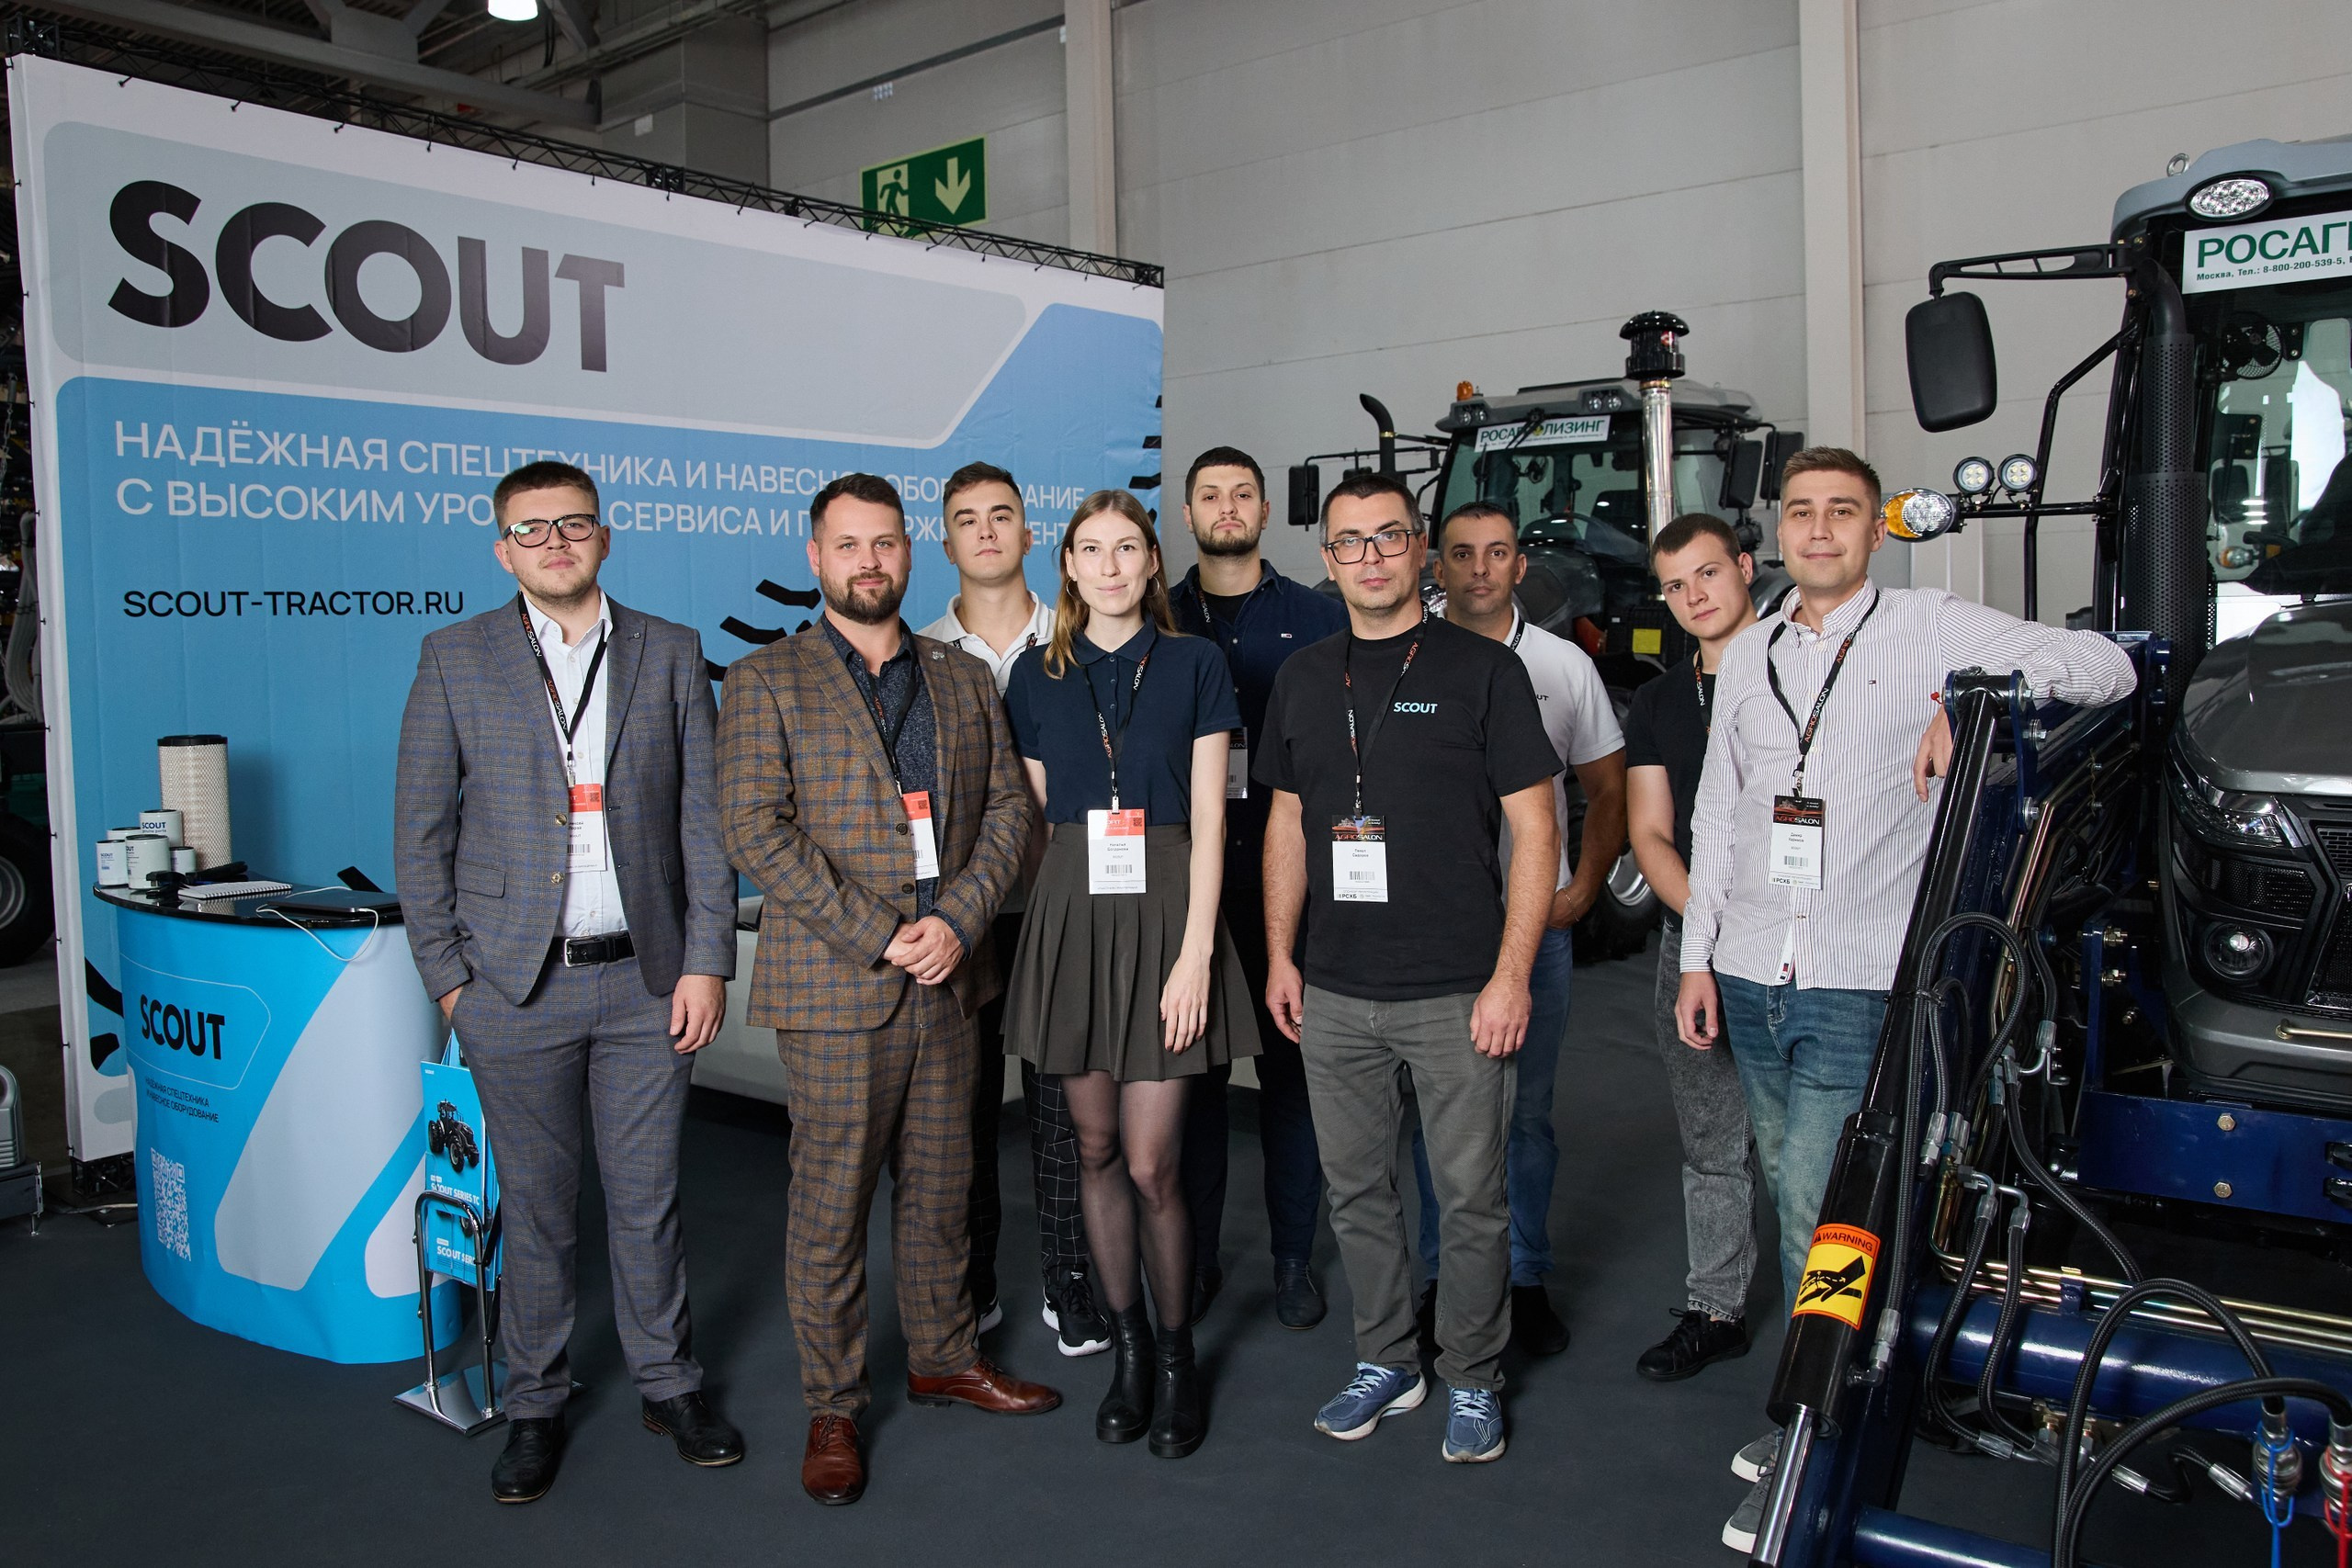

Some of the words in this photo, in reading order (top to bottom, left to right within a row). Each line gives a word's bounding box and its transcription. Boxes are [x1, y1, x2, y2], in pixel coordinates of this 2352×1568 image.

[107, 180, 625, 372] SCOUT
[2196, 271, 2234, 281] Москва,
[2237, 267, 2260, 276] Тел.:
[2263, 256, 2346, 274] 8-800-200-539-5,
[116, 420, 388, 471] НАДЁЖНАЯ
[685, 460, 707, 490] И
[117, 478, 153, 515] С
[167, 480, 404, 524] ВЫСОКИМ
[608, 501, 763, 536] СЕРВИСА
[770, 508, 790, 536] И
[123, 591, 463, 617] SCOUT-TRACTOR.RU
[521, 613, 542, 658] AGROSALON
[547, 679, 568, 730] AGROSALON
[1393, 702, 1439, 714] SCOUT
[1804, 688, 1829, 744] AGROSALON
[141, 821, 166, 829] SCOUT
[1775, 816, 1820, 825] AGROSALON
[140, 994, 225, 1060] SCOUT
[166, 1087, 209, 1108] СПЕЦТЕХНИКА
[171, 1100, 220, 1123] ОБОРУДОВАНИЕ
[453, 1189, 473, 1203] SERIES
[436, 1246, 461, 1260] SCOUT
[1822, 1232, 1873, 1252] WARNING
